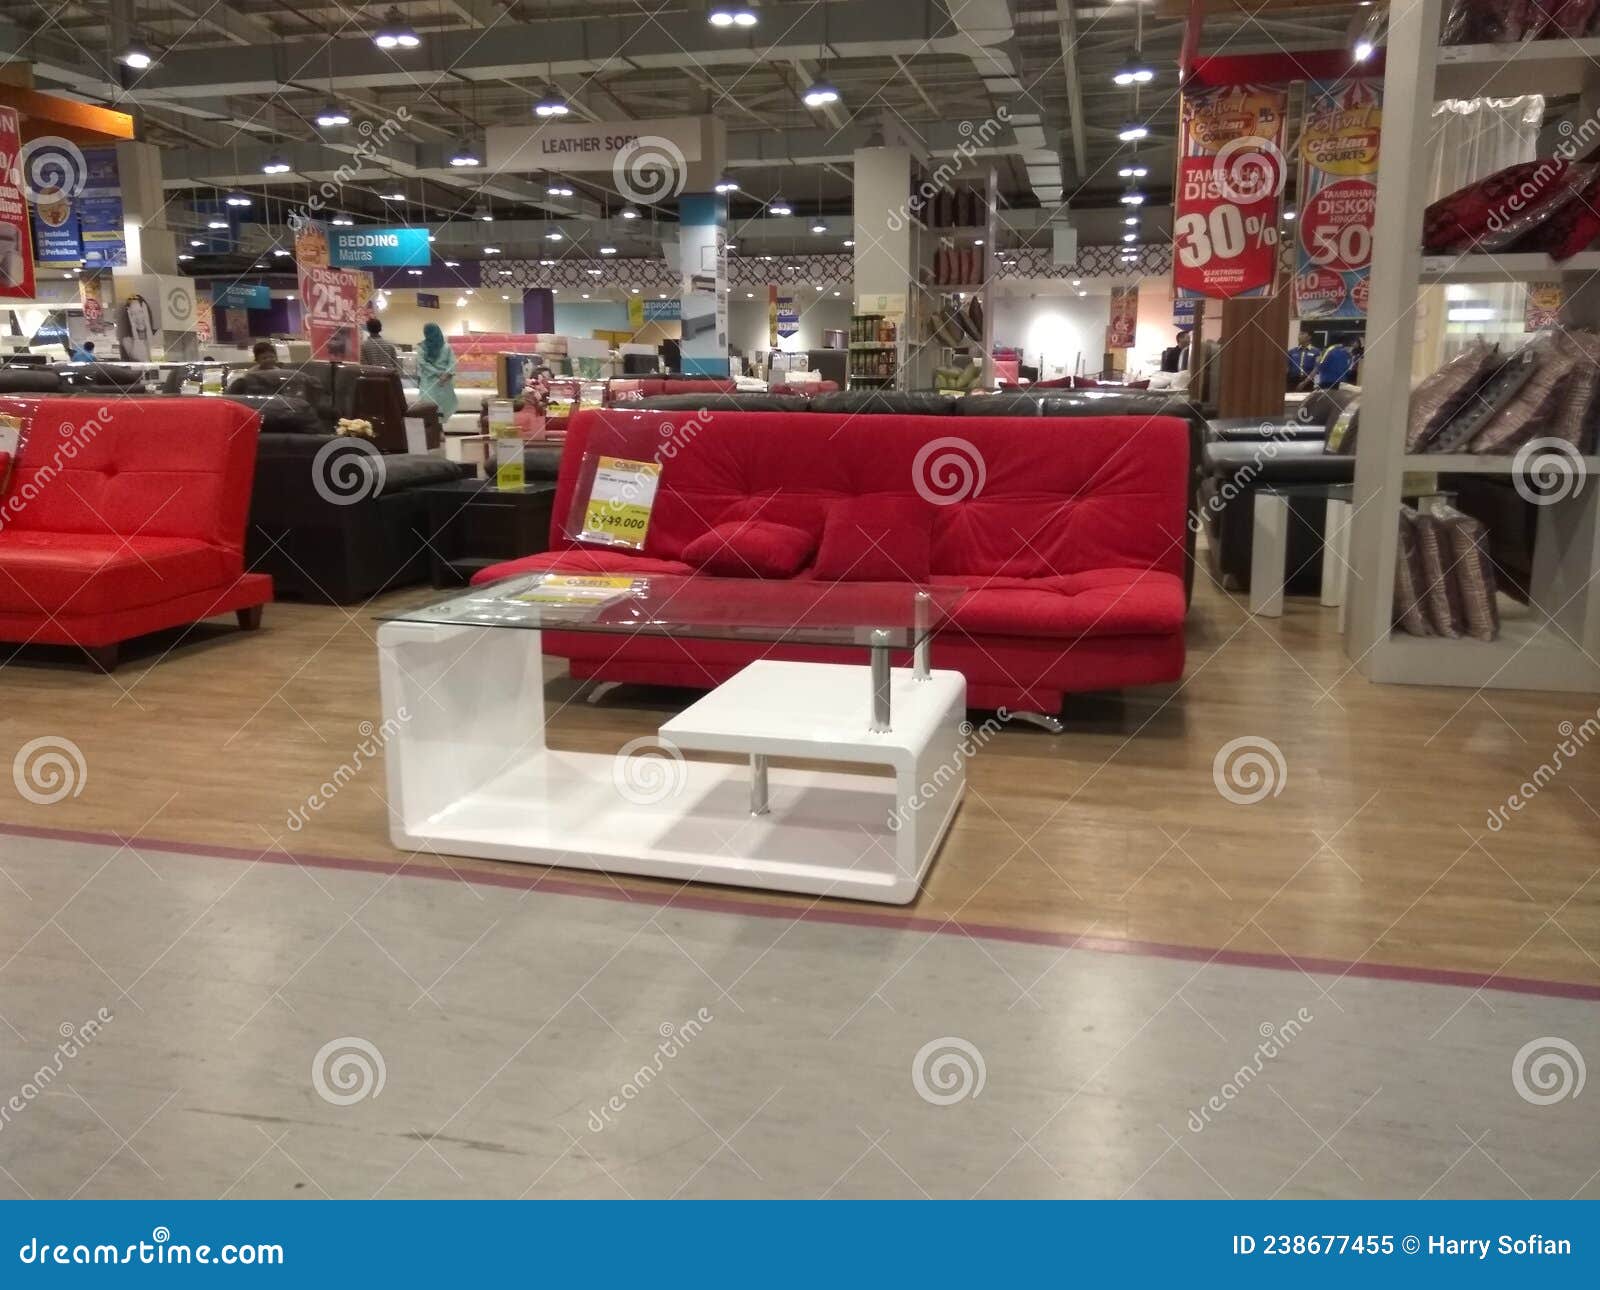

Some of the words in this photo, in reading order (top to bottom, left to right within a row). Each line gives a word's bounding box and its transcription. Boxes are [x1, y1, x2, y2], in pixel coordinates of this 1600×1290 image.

[541, 137, 600, 154] LEATHER
[1316, 149, 1366, 162] COURTS
[1318, 199, 1376, 215] DISKON
[338, 235, 399, 247] BEDDING
[1174, 204, 1278, 268] 30%
[1312, 224, 1374, 265] 50
[339, 249, 373, 261] Matras
[312, 269, 357, 286] DISKON
